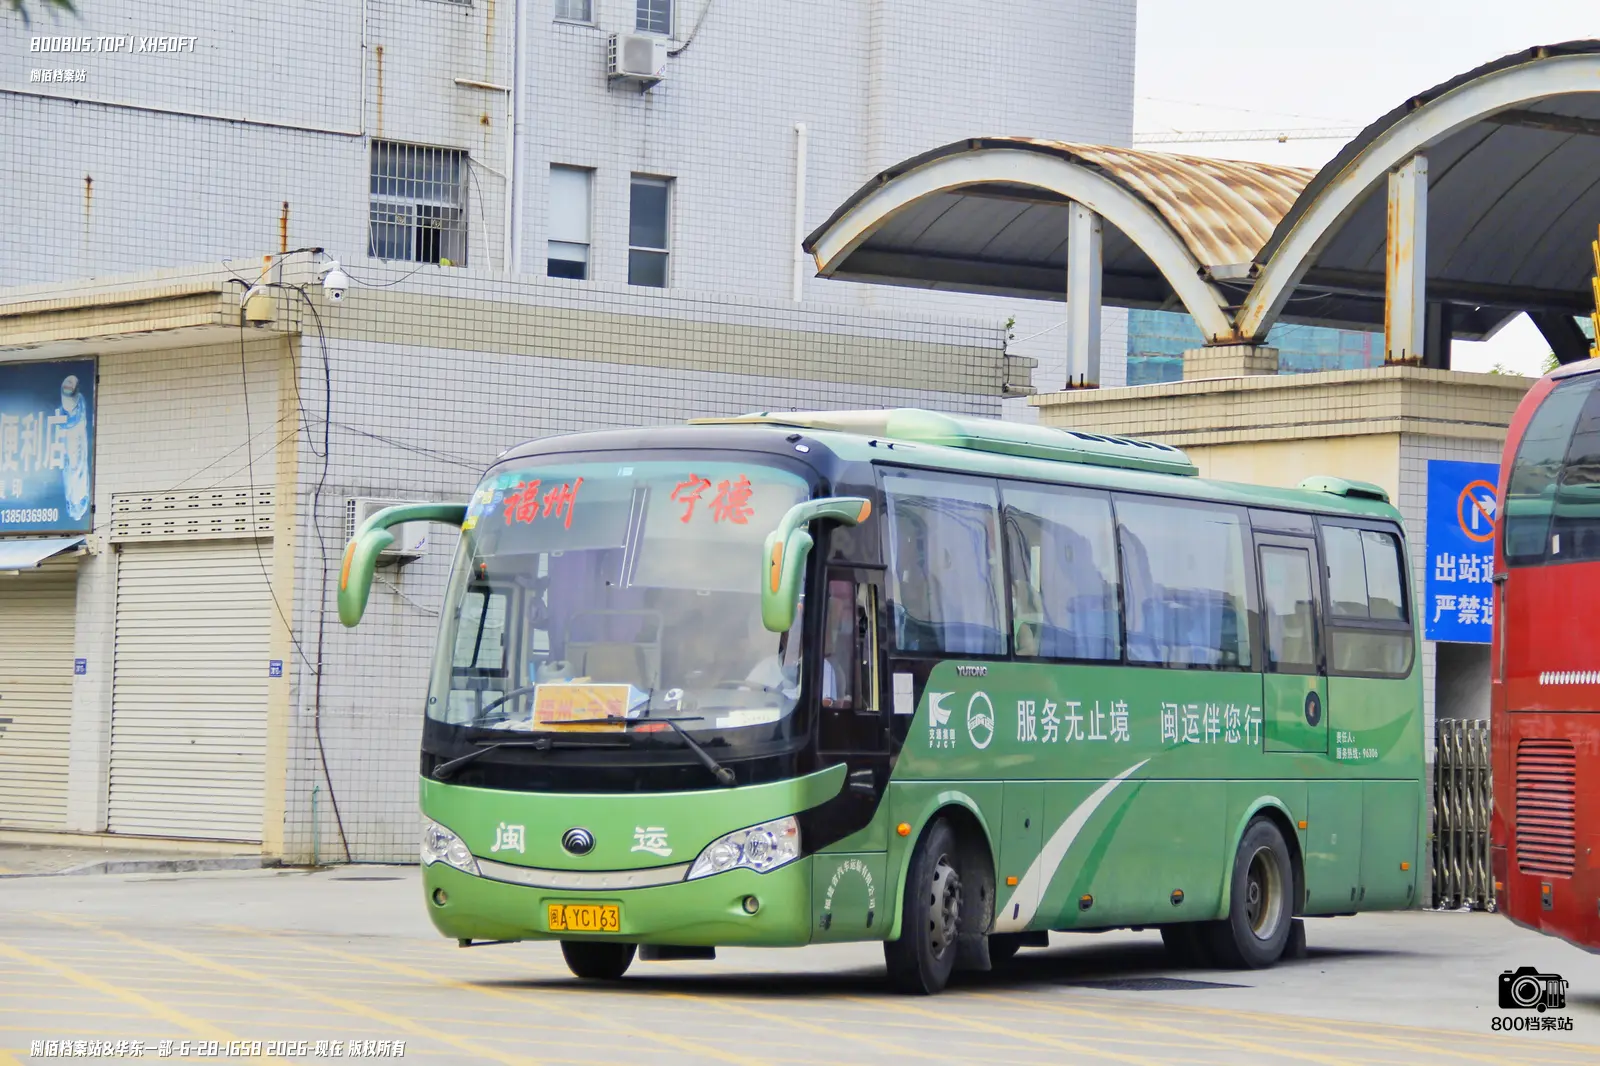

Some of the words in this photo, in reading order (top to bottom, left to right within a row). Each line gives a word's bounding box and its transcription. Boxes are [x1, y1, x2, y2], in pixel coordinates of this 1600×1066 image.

[0, 508, 58, 523] 13850369890
[503, 476, 584, 530] 福州
[670, 472, 755, 525] 宁德
[956, 665, 988, 677] YUTONG
[1016, 699, 1131, 744] 服务无止境
[1160, 701, 1263, 746] 闽运伴您行
[490, 821, 526, 854] 闽
[630, 826, 673, 857] 运
